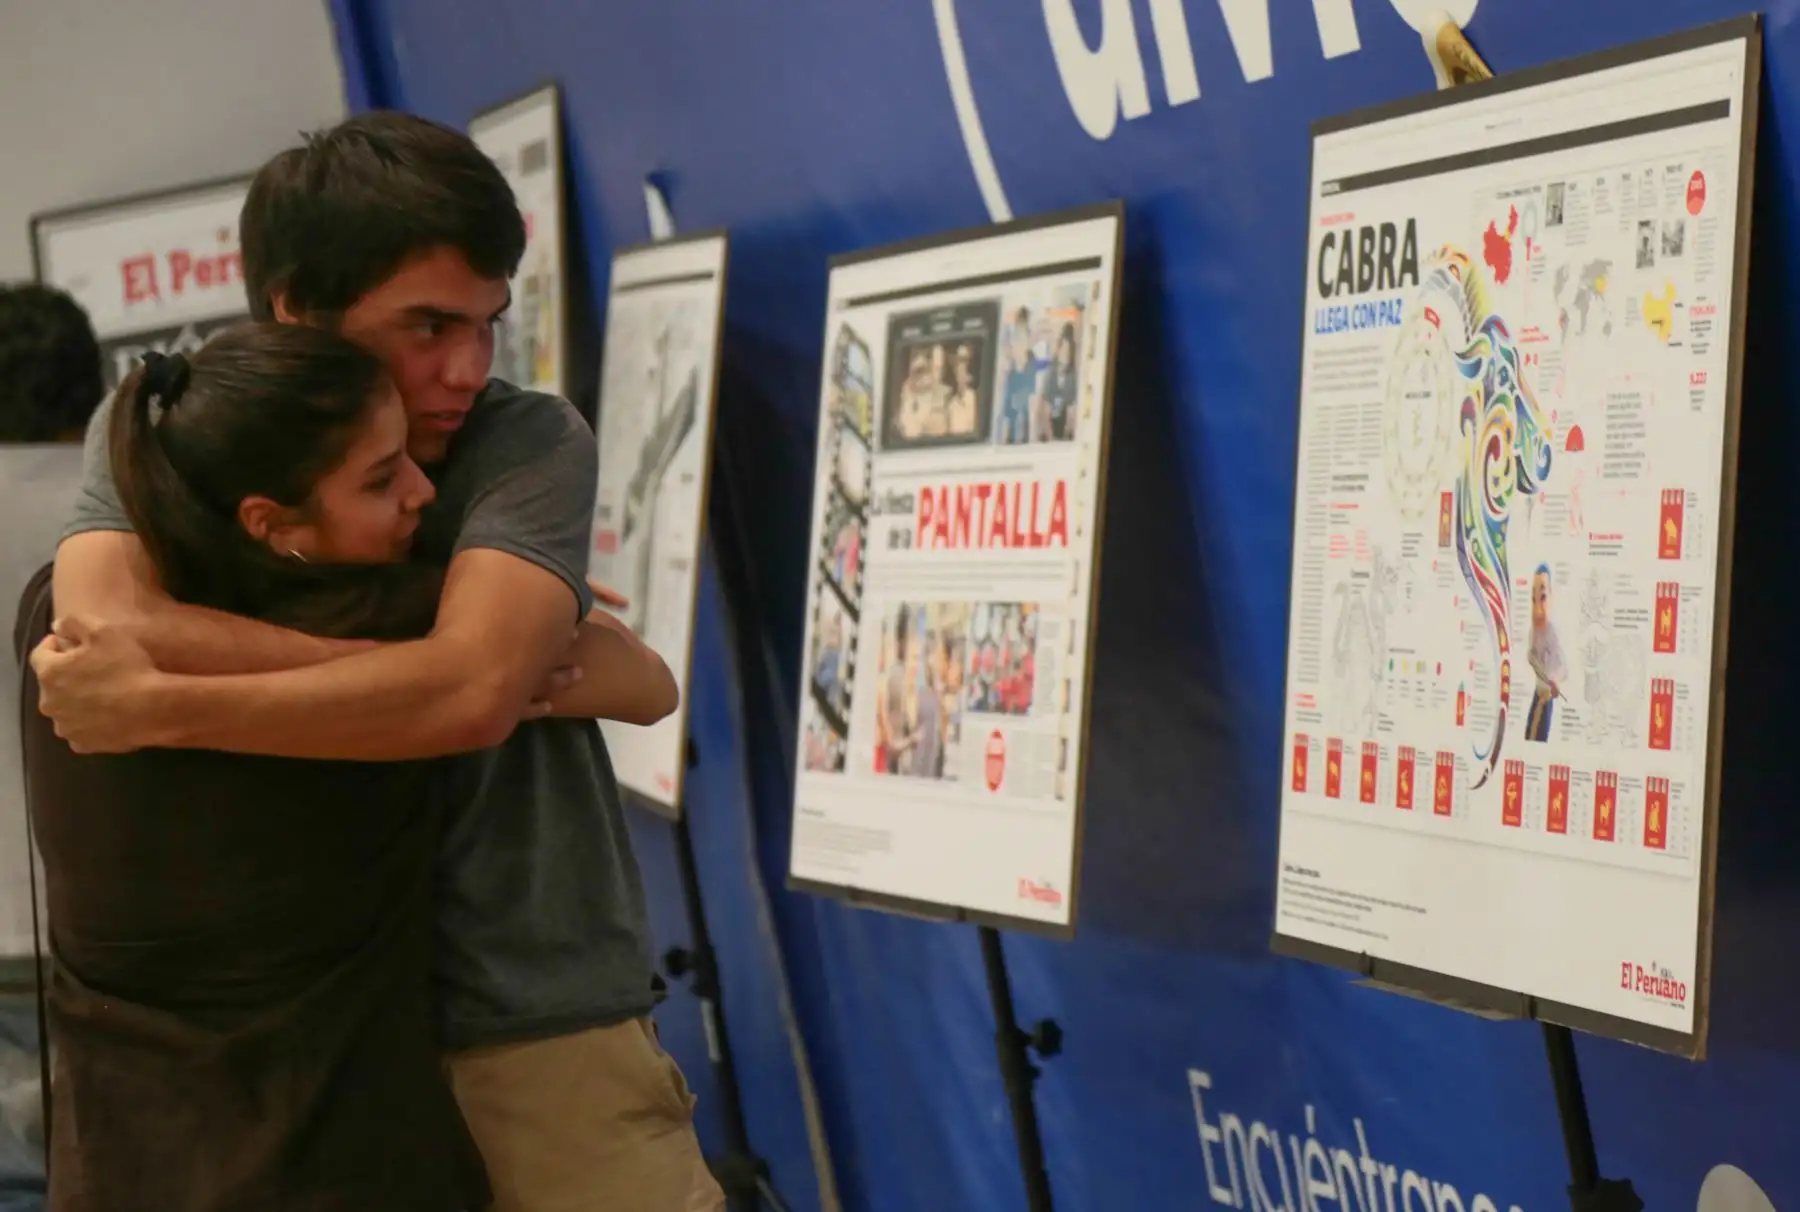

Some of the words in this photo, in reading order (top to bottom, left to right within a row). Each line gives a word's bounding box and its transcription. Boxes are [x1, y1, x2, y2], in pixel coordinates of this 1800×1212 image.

[120, 252, 159, 304] El
[167, 247, 245, 294] Per
[1317, 217, 1419, 299] CABRA
[1315, 305, 1348, 335] LLEGA
[1351, 301, 1377, 331] CON
[1379, 298, 1403, 327] PAZ
[916, 480, 1068, 549] PANTALLA
[1621, 961, 1632, 990] El
[1635, 964, 1686, 1002] Peruano
[1187, 1068, 1527, 1212] Encuéntr
